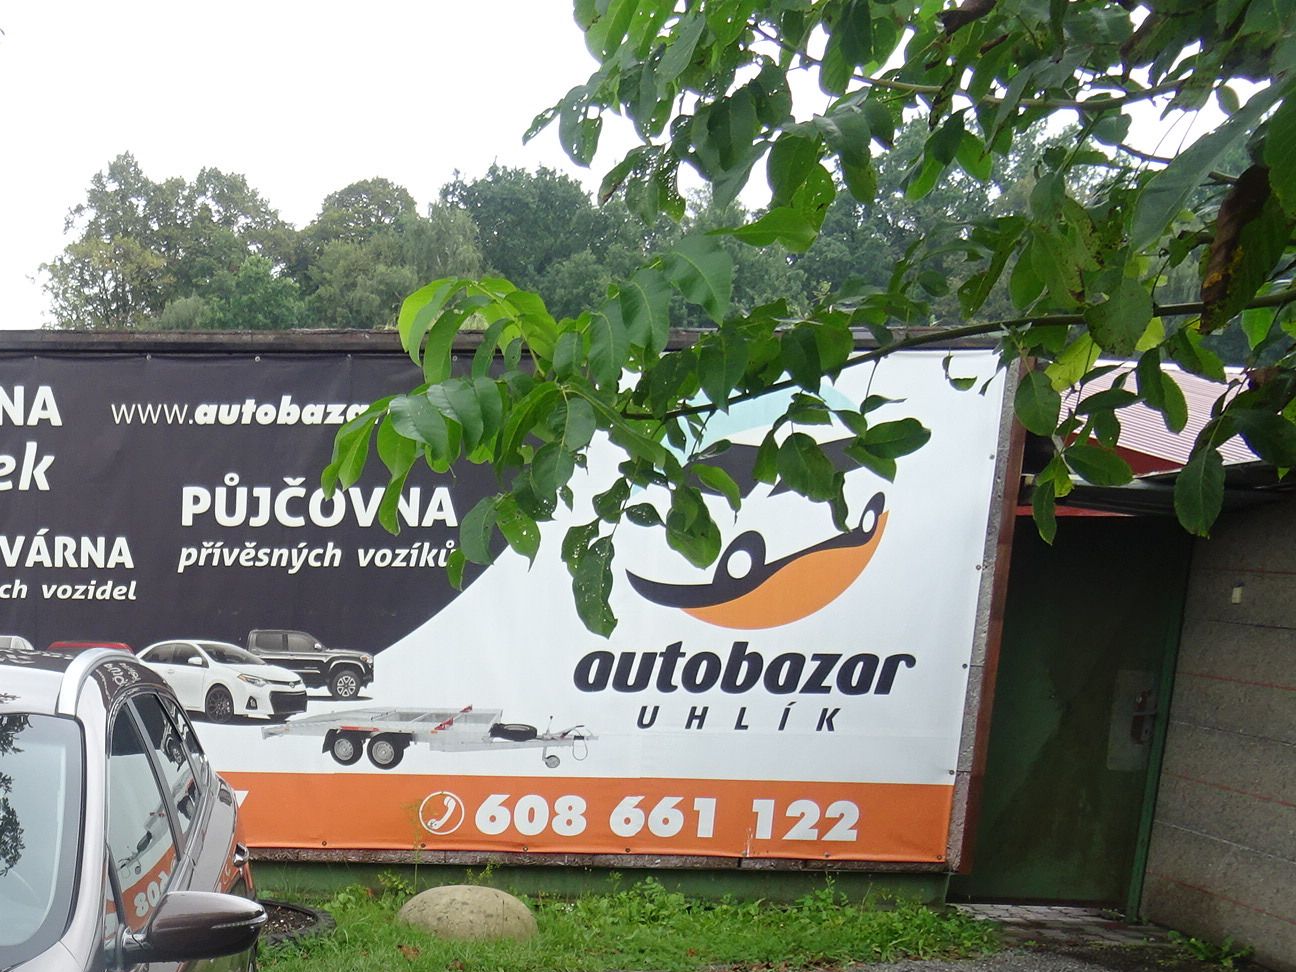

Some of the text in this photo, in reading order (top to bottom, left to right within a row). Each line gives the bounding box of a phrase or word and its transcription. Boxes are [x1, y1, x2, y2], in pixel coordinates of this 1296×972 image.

[110, 395, 382, 426] www.autobaza
[181, 472, 458, 527] PŮJČOVNA
[177, 540, 342, 574] přívěsných
[42, 580, 137, 601] vozidel
[573, 641, 917, 696] autobazar
[636, 702, 841, 732] UHLÍK
[475, 794, 860, 842] 608 661 122
